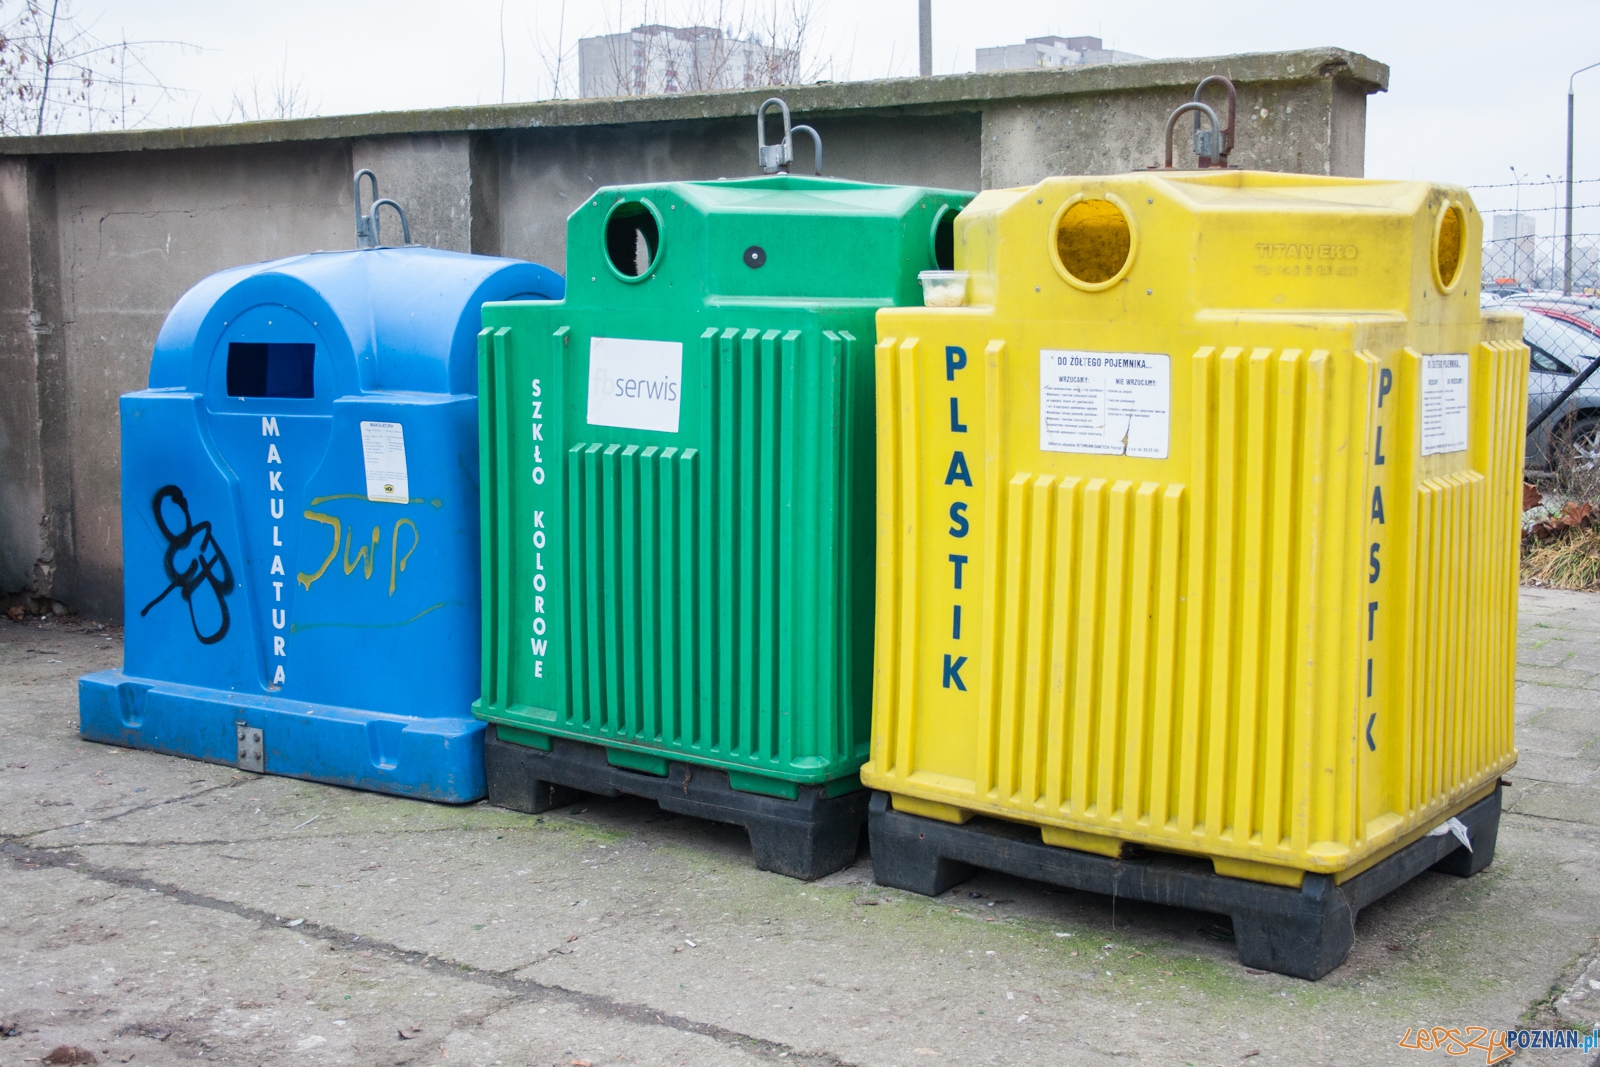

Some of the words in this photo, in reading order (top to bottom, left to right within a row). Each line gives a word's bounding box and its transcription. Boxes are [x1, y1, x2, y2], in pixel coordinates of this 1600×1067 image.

[1255, 244, 1313, 260] TITAN
[1318, 245, 1358, 260] EKO
[1057, 357, 1067, 366] DO
[531, 378, 546, 486] SZKŁO
[262, 416, 286, 684] MAKULATURA
[942, 346, 973, 692] PLASTIK
[532, 510, 548, 679] KOLOROWE
